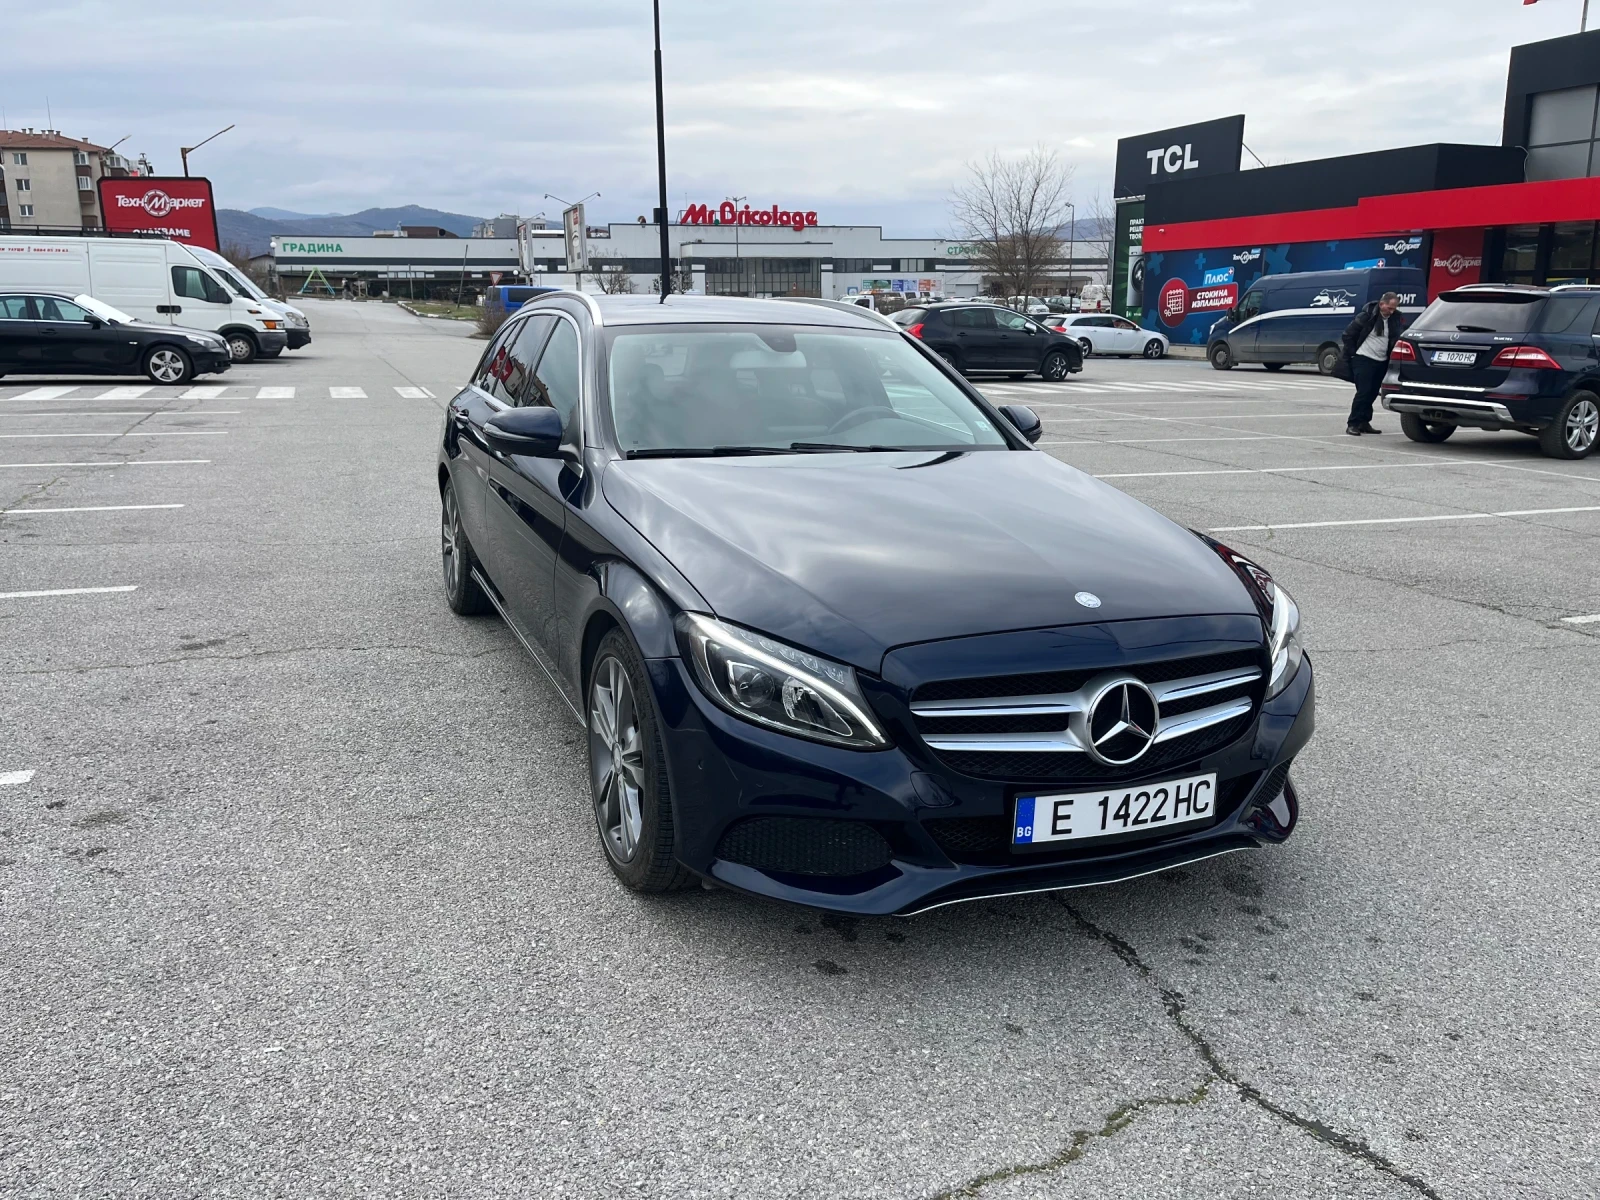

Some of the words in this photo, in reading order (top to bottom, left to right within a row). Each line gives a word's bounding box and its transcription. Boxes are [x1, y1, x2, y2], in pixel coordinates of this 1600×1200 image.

[1146, 143, 1199, 175] TCL
[282, 243, 343, 254] ГРАДИНА
[1191, 296, 1234, 308] ИЗПЛАЩАНЕ
[1051, 800, 1074, 835] E
[1016, 826, 1032, 838] BG
